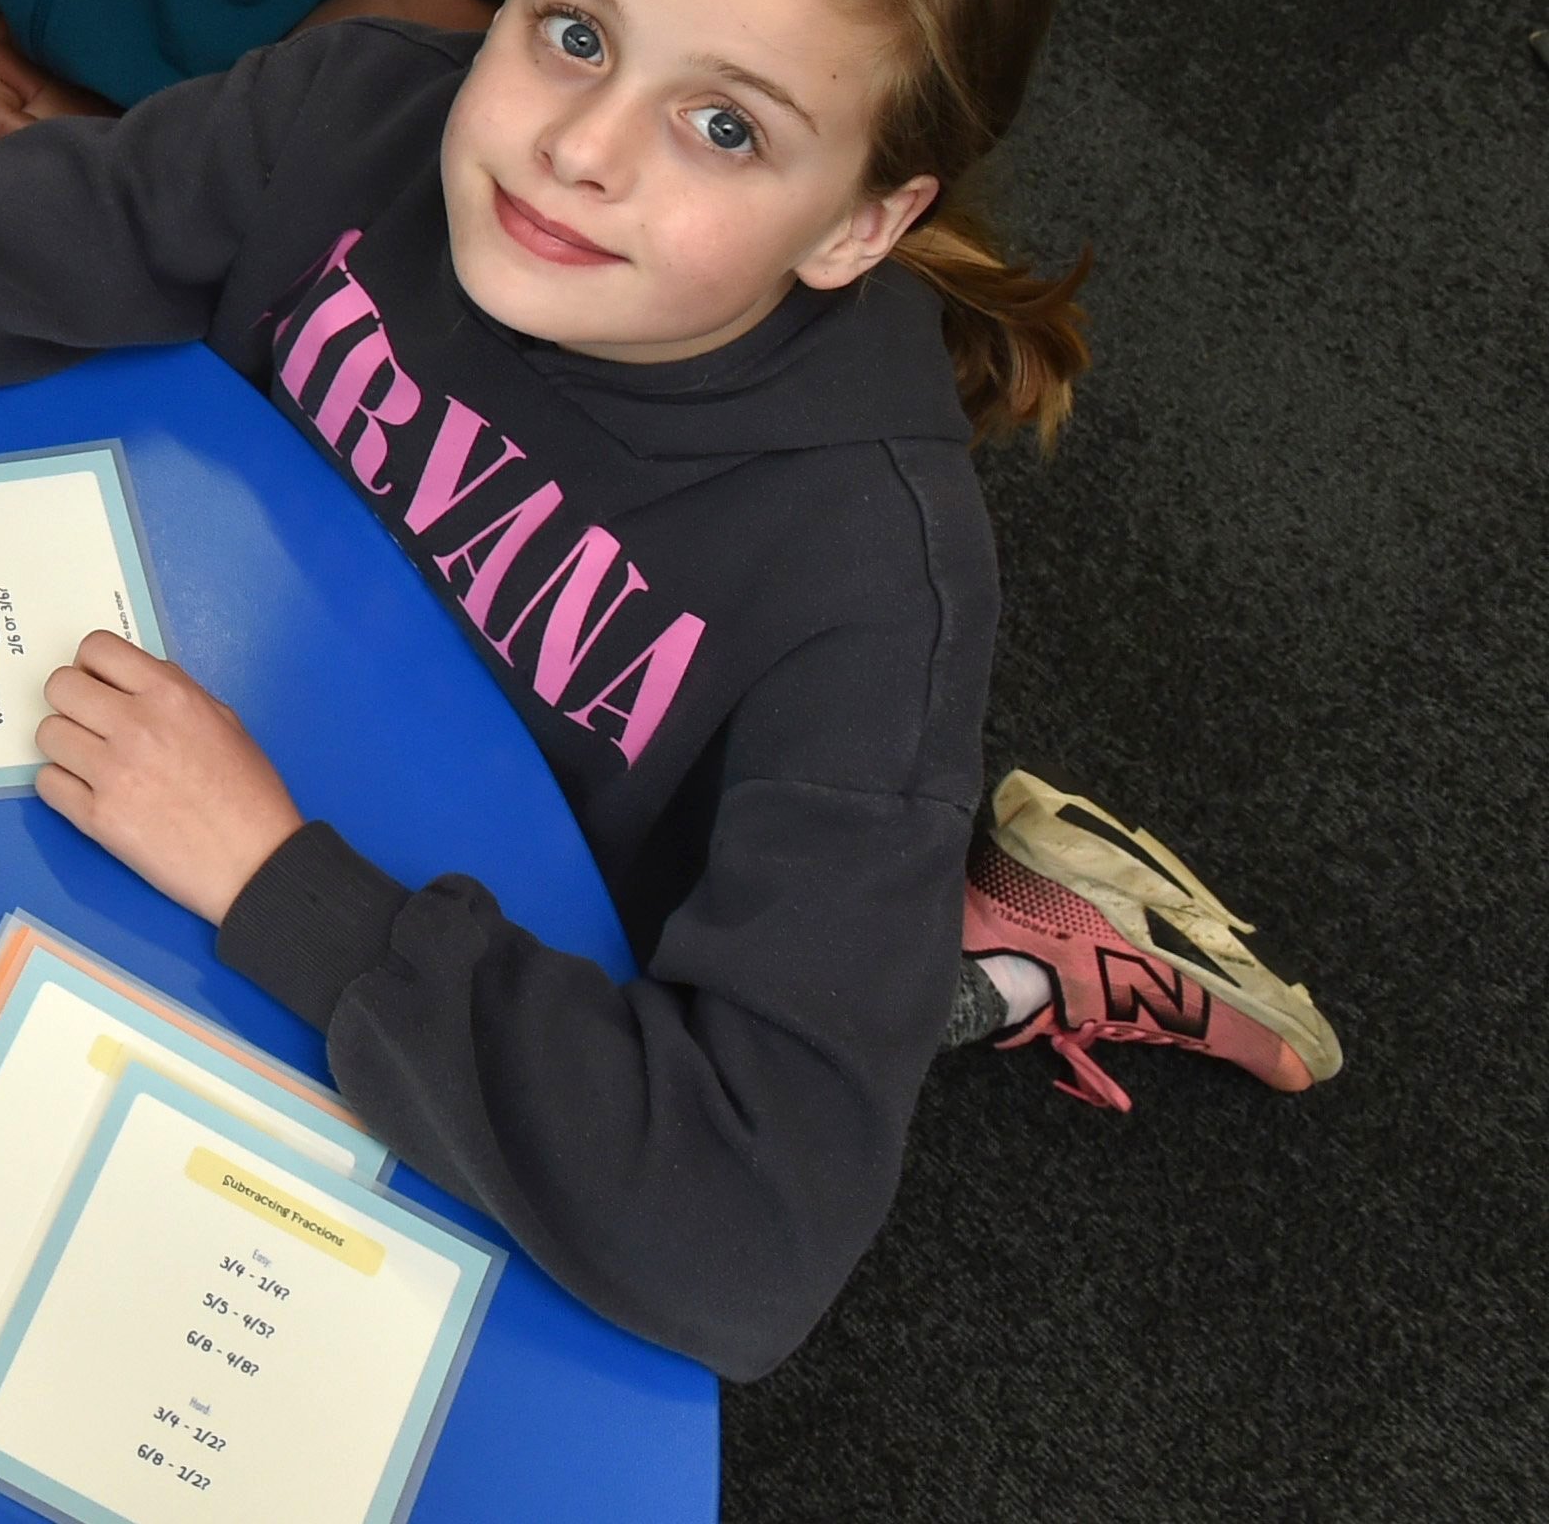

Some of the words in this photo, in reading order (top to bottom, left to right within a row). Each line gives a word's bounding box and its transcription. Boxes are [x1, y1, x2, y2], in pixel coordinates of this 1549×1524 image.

[4, 616, 17, 632] or
[7, 634, 25, 655] 2/6
[222, 1174, 290, 1218] Subtracting
[291, 1211, 345, 1247] Fractions
[219, 1255, 246, 1278] 3/4
[257, 1276, 290, 1301] 1/4?
[202, 1292, 229, 1315] 5/5
[242, 1314, 275, 1339] 4/5?
[186, 1330, 213, 1352] 6/8
[226, 1352, 260, 1377] 4/8?
[153, 1406, 181, 1428] 3/4
[192, 1427, 227, 1452] 1/2?
[137, 1443, 165, 1466] 6/8
[177, 1466, 211, 1491] 1/2?
